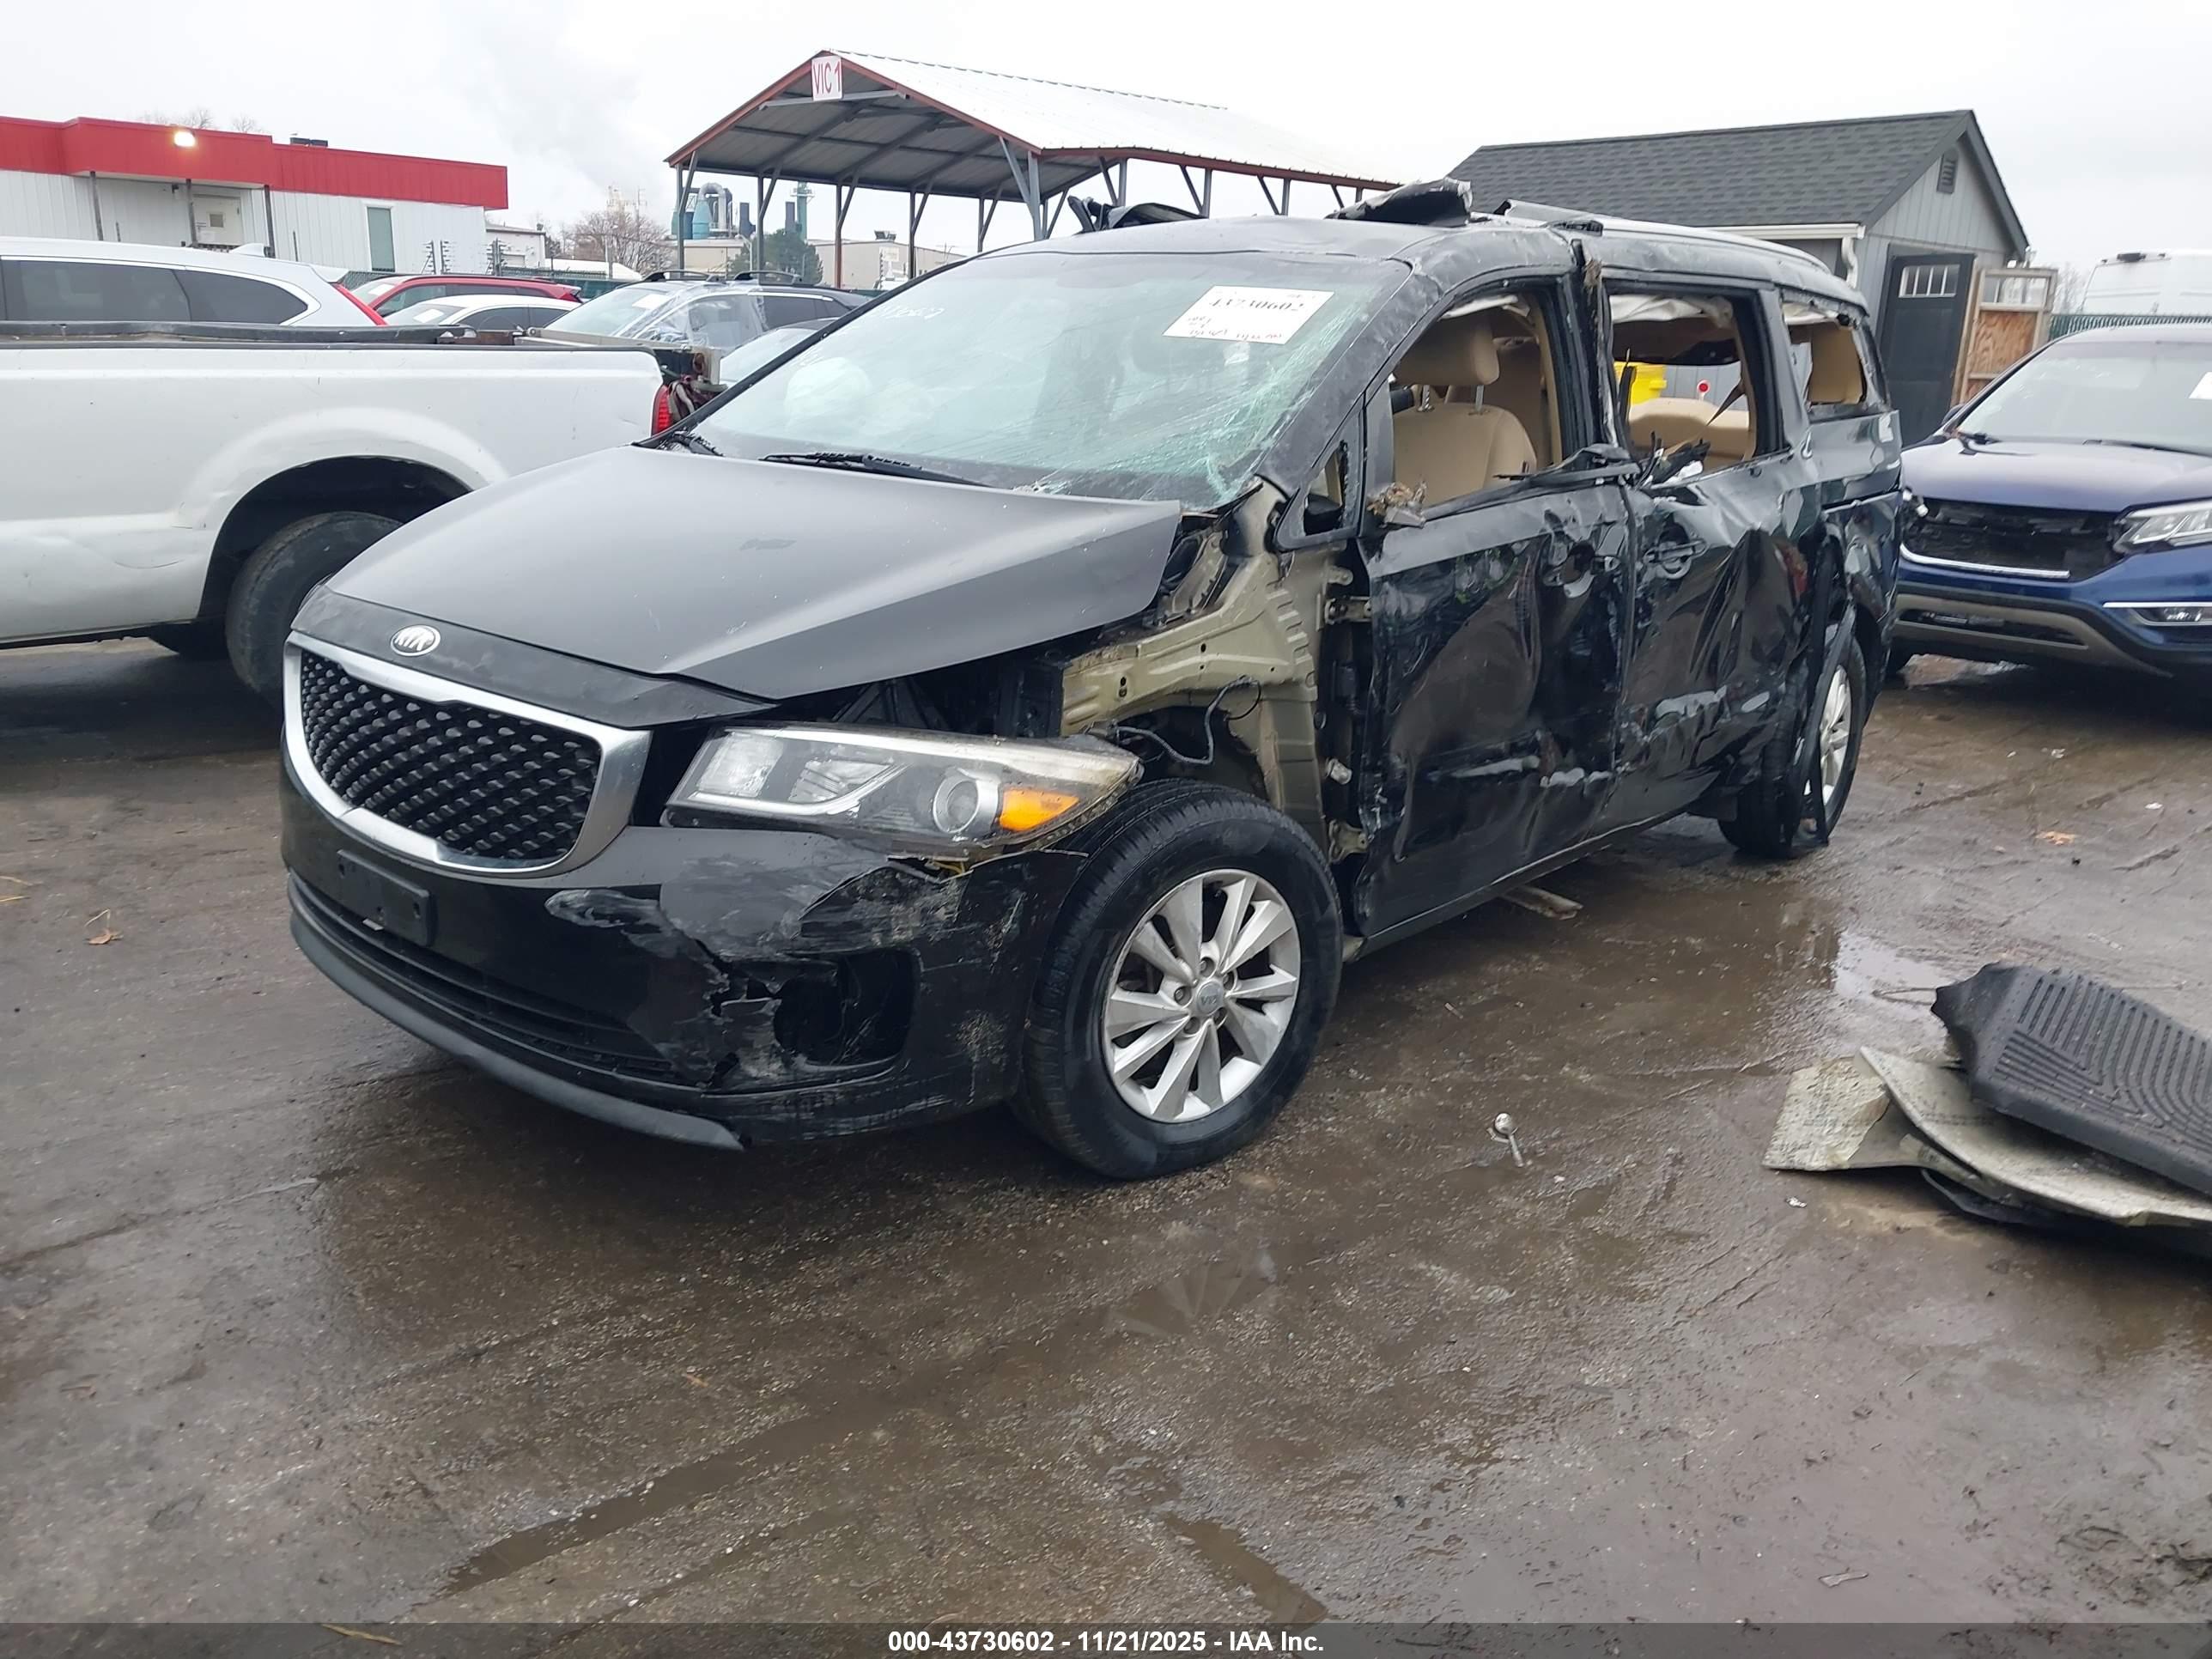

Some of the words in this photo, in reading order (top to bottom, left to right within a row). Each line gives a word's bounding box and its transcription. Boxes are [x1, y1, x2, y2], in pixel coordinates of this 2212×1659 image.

[812, 61, 832, 95] VIC
[834, 60, 842, 94] 1
[393, 625, 436, 652] KIA
